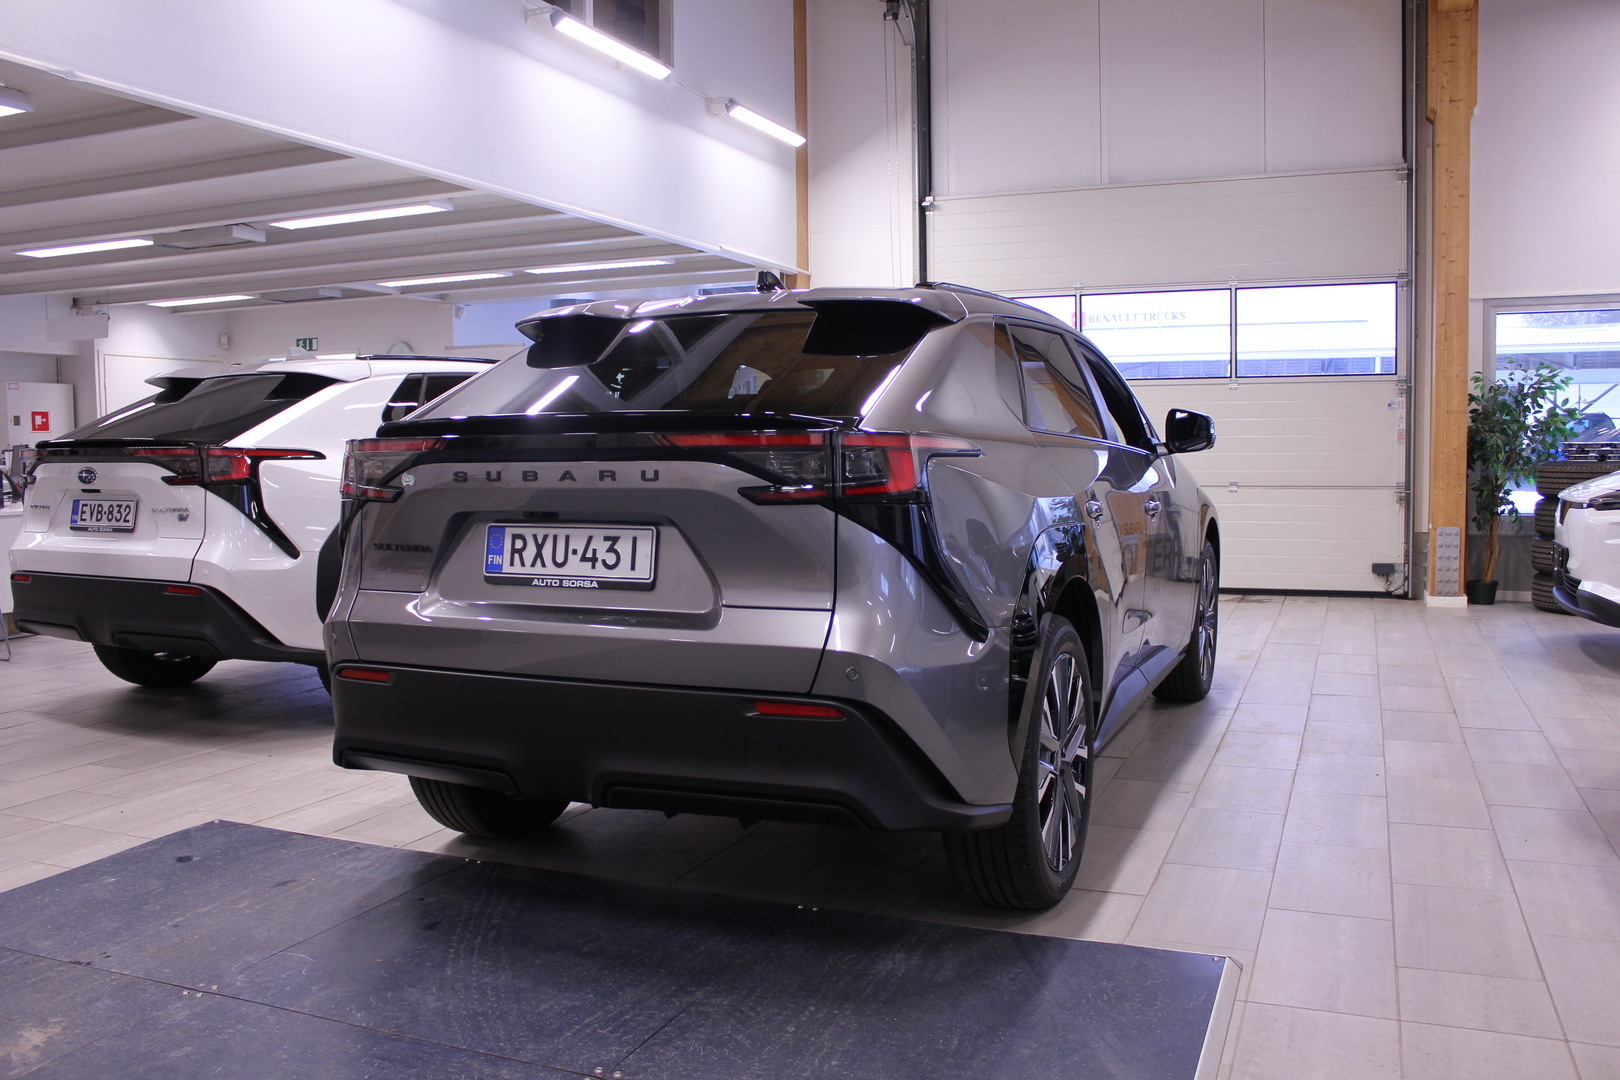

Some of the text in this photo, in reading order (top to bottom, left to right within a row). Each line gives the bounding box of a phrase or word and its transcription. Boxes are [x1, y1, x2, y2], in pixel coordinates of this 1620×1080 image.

[452, 469, 660, 483] SUBARU
[80, 503, 132, 523] EVB-832
[487, 554, 503, 565] FIN
[508, 533, 638, 572] RXU-431
[531, 578, 599, 589] AUTO SORSA
